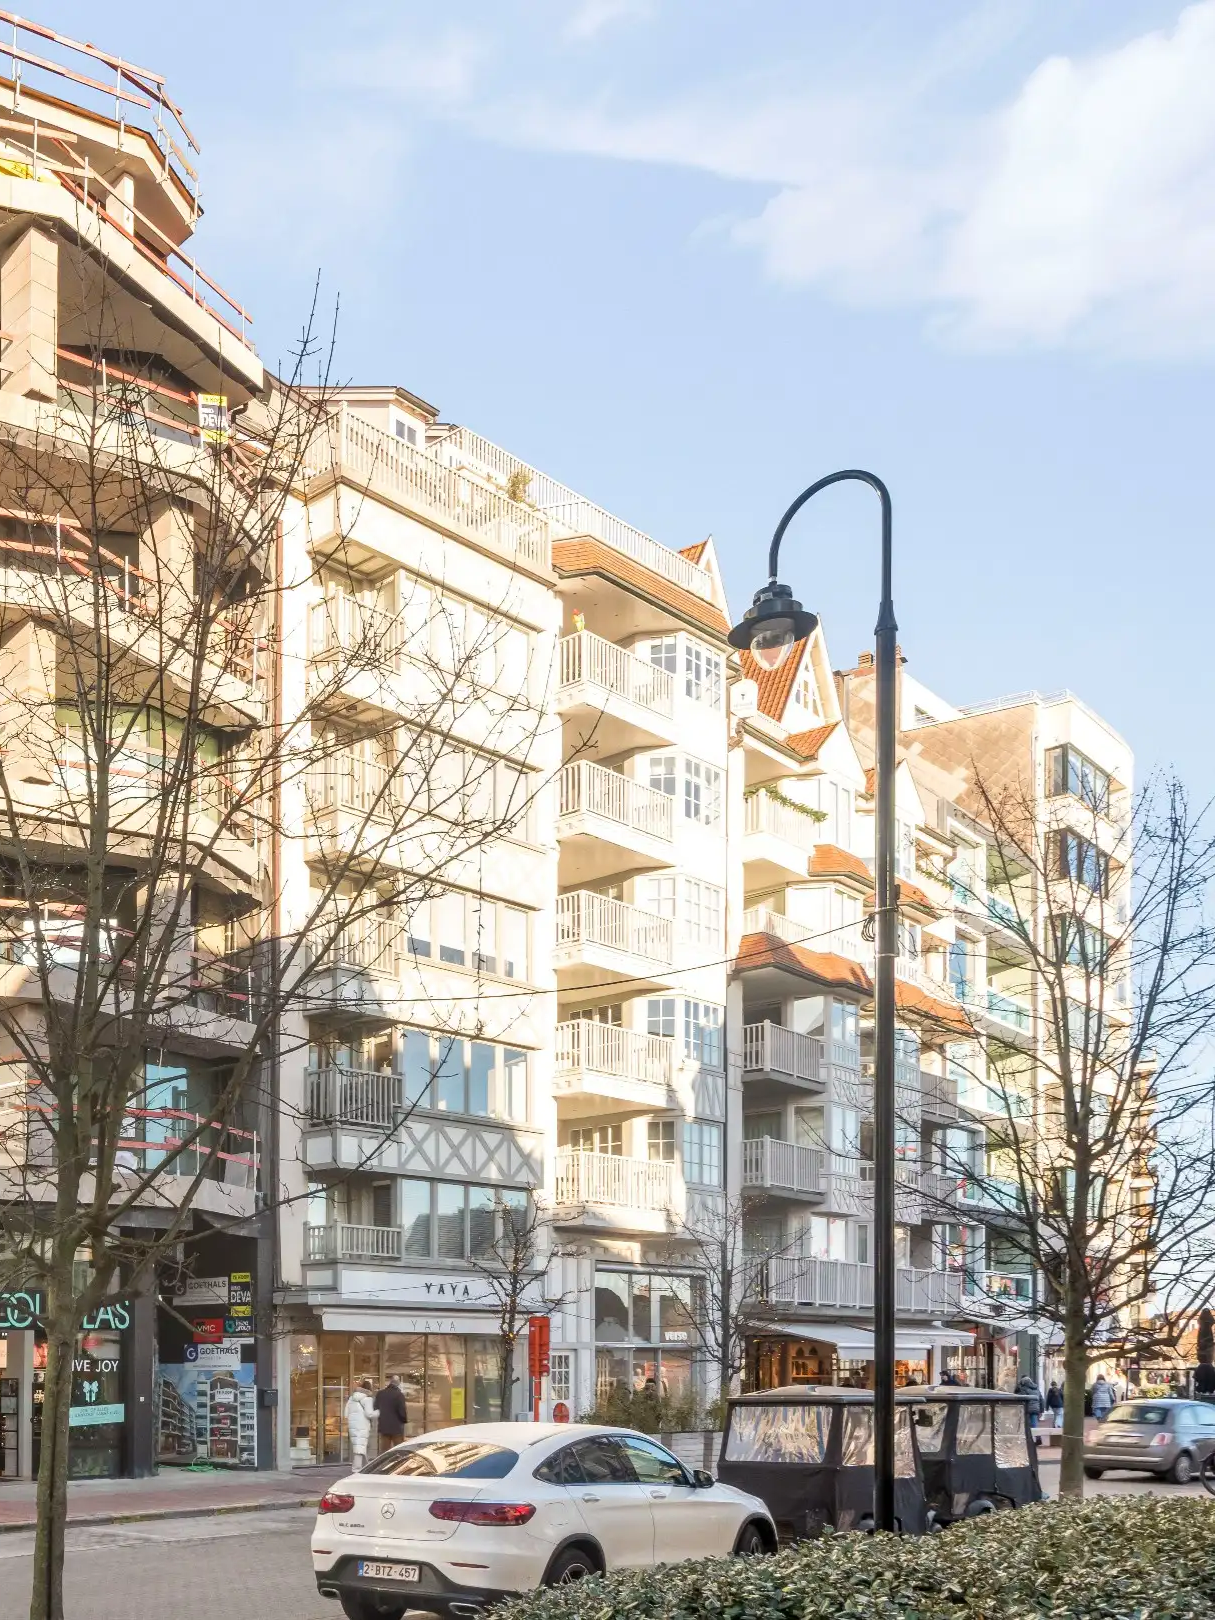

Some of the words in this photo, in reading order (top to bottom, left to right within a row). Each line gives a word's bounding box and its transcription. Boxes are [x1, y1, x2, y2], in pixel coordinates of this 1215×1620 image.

[188, 1280, 227, 1290] GOETHALS
[425, 1282, 469, 1296] YAYA
[230, 1291, 251, 1302] DEVA
[411, 1319, 456, 1332] YAYA
[199, 1347, 239, 1355] GOETHALS
[71, 1360, 91, 1372] IVE
[95, 1360, 119, 1372] JOY
[364, 1563, 417, 1579] 2-BTZ-457
